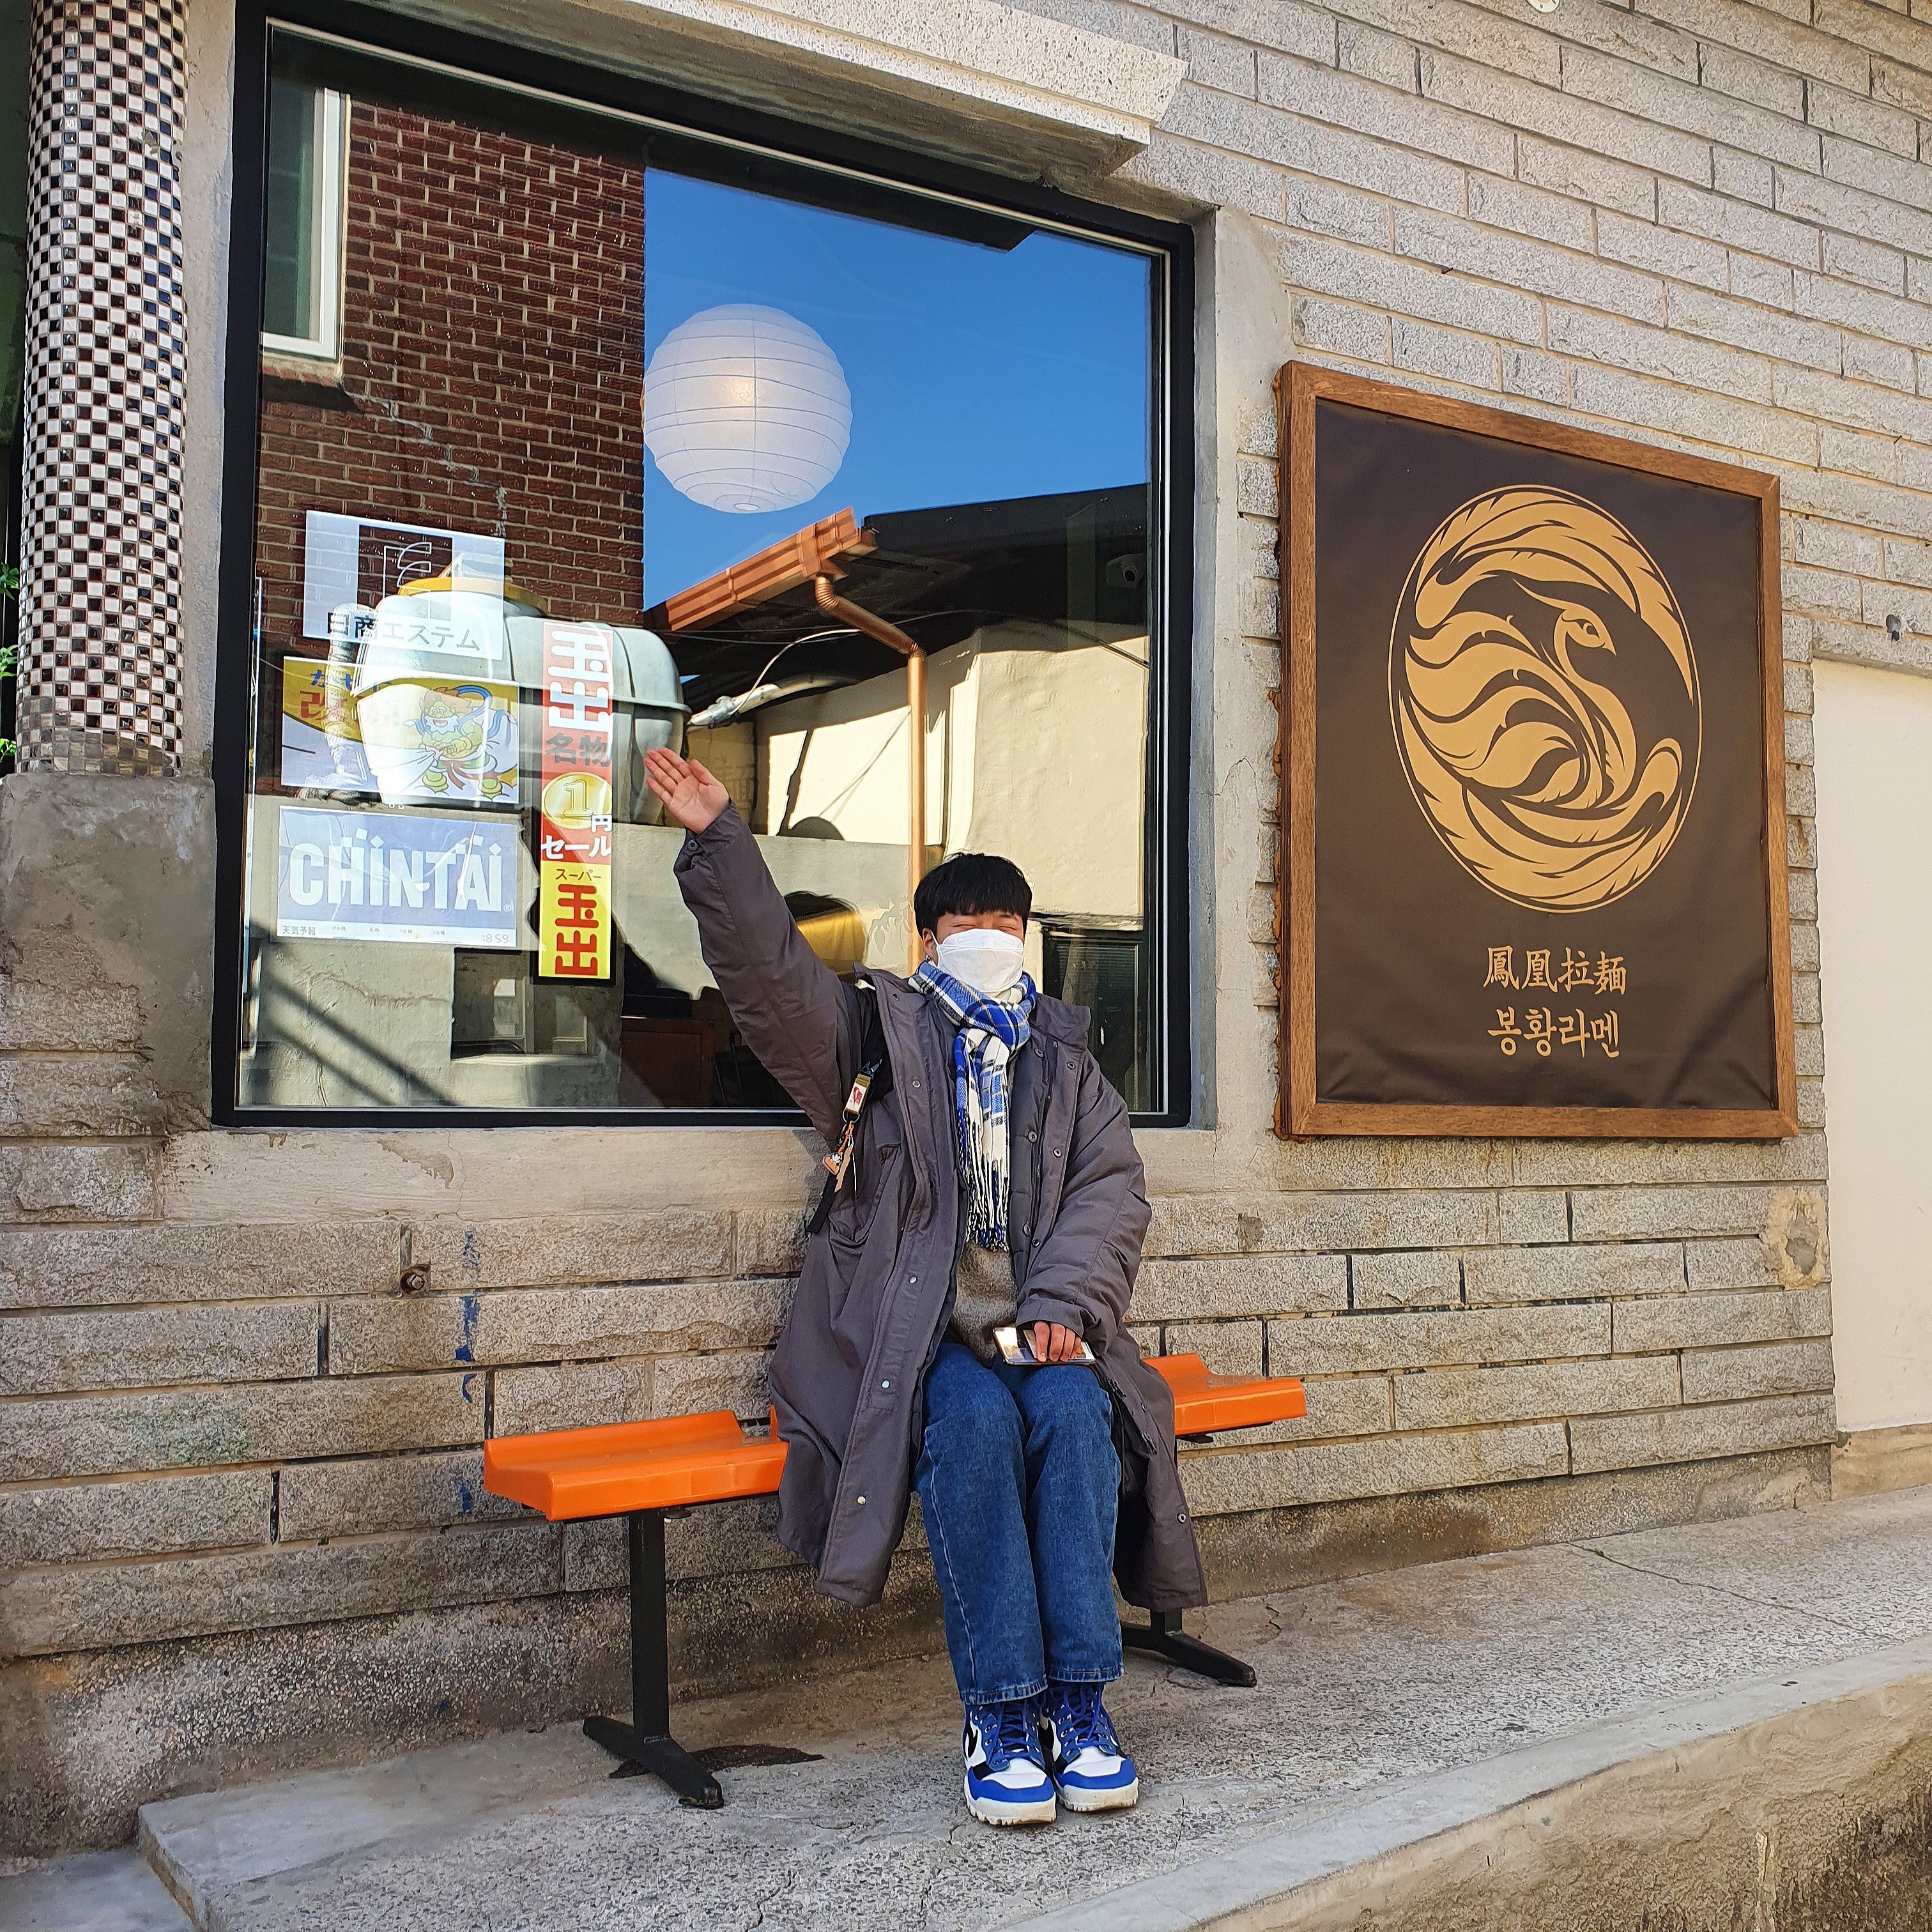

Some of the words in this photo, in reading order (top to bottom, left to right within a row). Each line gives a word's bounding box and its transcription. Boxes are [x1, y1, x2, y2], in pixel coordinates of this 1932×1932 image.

[545, 733, 611, 767] 名物
[541, 835, 612, 859] セール
[555, 868, 602, 882] スーパー
[555, 884, 599, 976] 玉出
[1487, 1006, 1621, 1058] 봉황라멘
